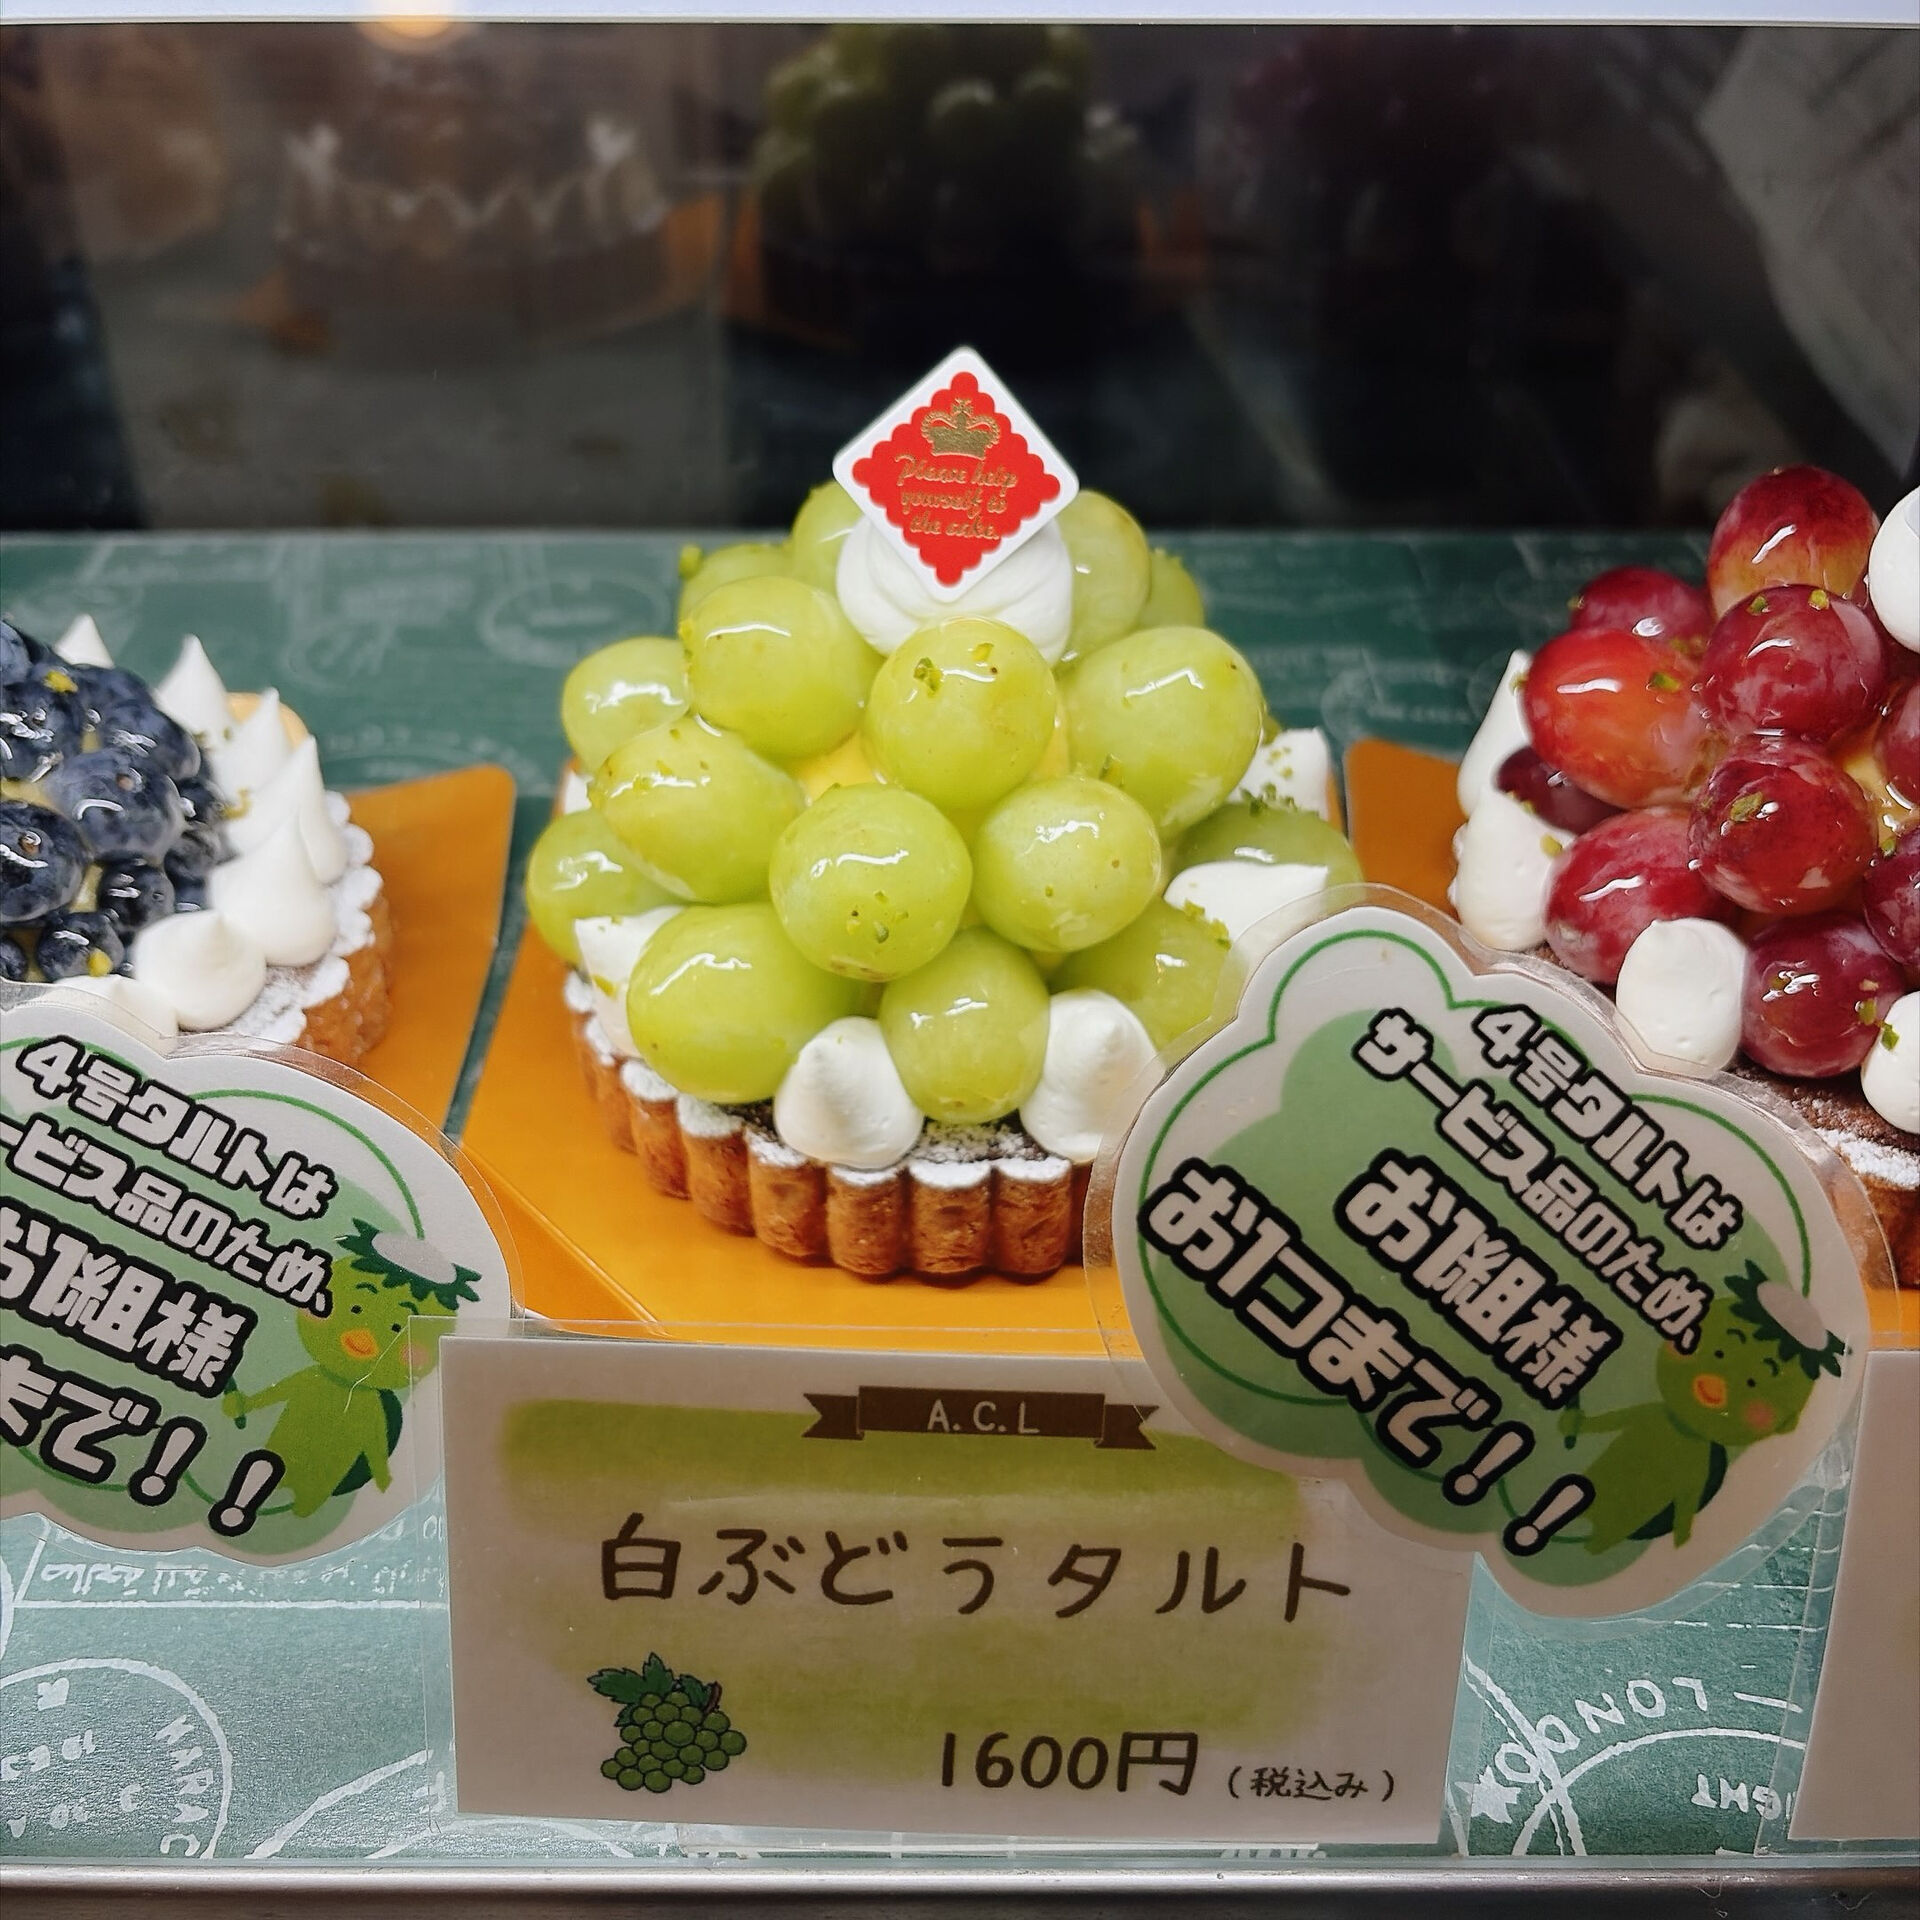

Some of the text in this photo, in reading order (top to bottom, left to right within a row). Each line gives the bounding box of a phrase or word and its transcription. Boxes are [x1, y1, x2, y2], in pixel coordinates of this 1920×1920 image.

[895, 454, 1017, 497] Please help
[901, 488, 1007, 519] yourself to
[910, 511, 942, 535] the
[17, 1035, 338, 1219] 4号タルトは
[1472, 1004, 1742, 1251] 4号タルトは
[1353, 1008, 1714, 1354] サービス品のため、
[1333, 1147, 1622, 1409] お1組様
[927, 1399, 1040, 1435] A.C.L
[602, 1512, 1351, 1622] 白ぶどうタルト
[941, 1731, 1199, 1796] 1600円
